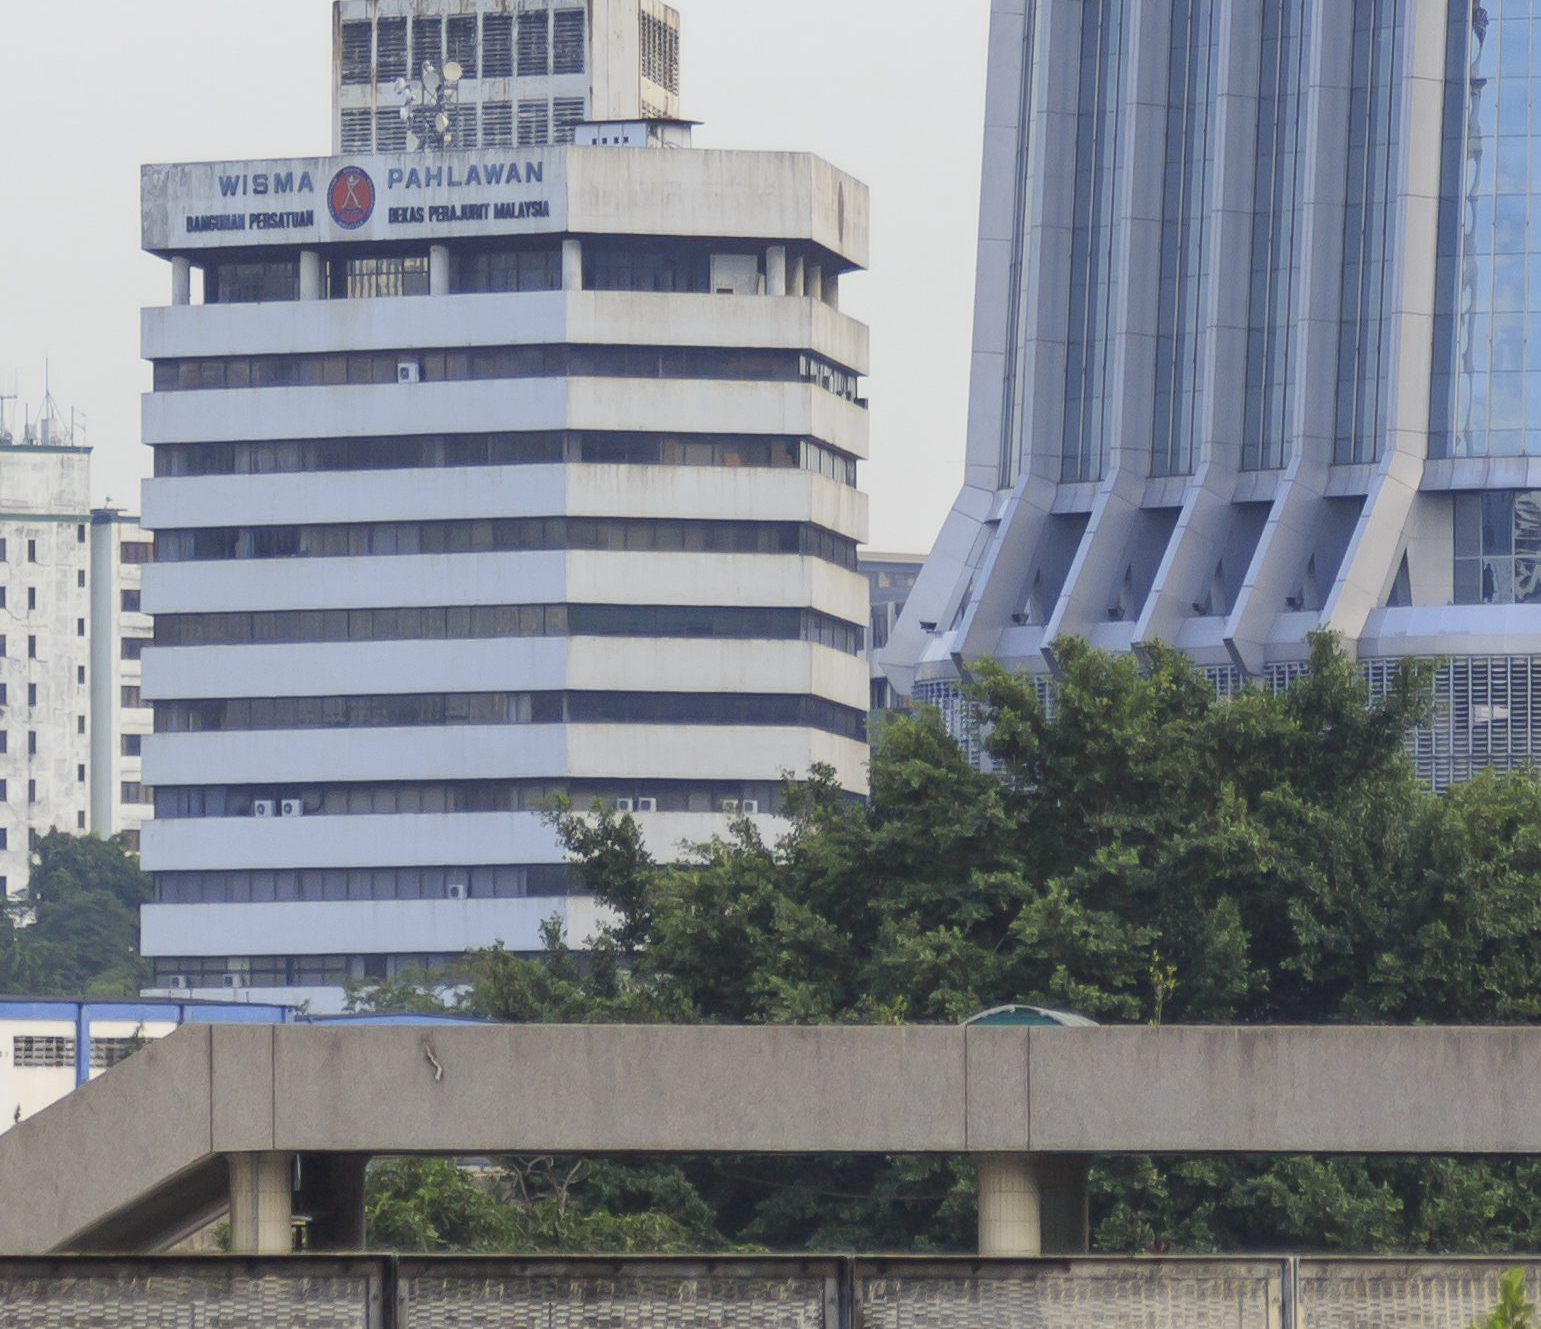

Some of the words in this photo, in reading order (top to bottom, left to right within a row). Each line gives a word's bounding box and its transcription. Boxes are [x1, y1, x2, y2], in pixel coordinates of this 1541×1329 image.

[218, 171, 314, 197] WISMA
[387, 160, 543, 190] PAHLAWAN
[185, 213, 246, 233] BANGUNAN
[248, 209, 314, 231] PERSATUAN
[428, 202, 491, 223] PERAJURIT
[492, 199, 550, 220] MALAYSIA
